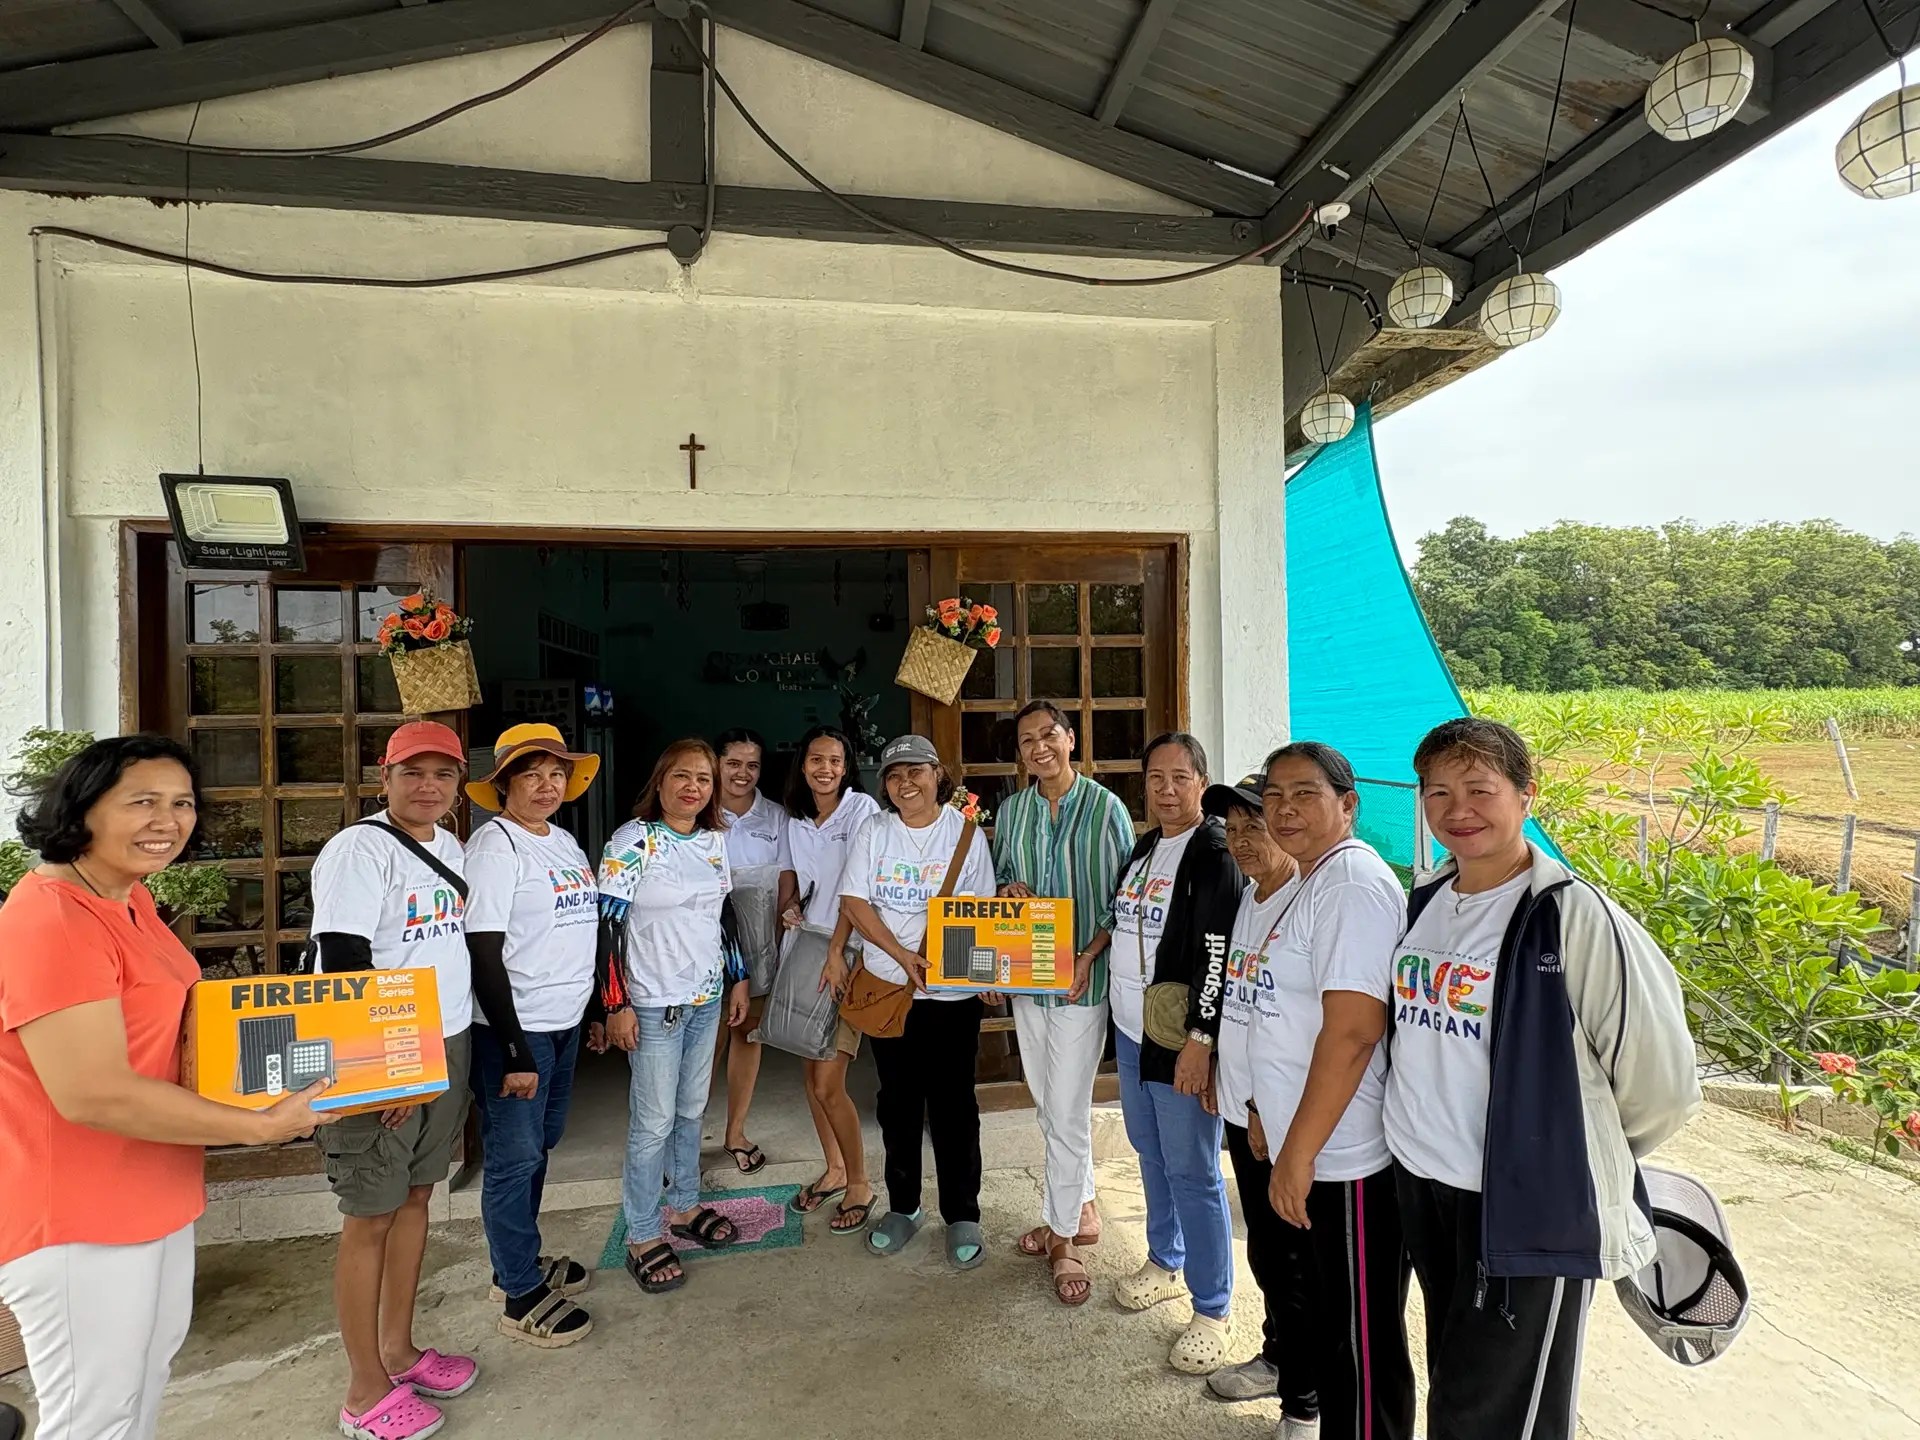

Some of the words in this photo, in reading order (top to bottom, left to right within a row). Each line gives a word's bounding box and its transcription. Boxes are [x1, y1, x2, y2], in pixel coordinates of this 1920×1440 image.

[200, 545, 230, 555] Solar
[235, 547, 264, 557] Light
[549, 867, 597, 893] LOV
[876, 859, 947, 886] LOVE
[876, 884, 904, 900] ANG
[554, 893, 581, 910] ANG
[943, 901, 1026, 919] FIREFLY
[1029, 901, 1056, 910] BASIC
[1030, 911, 1056, 921] Series
[402, 920, 465, 943] CAATA
[994, 923, 1027, 932] SOLAR
[231, 976, 371, 1010] FIREFLY
[376, 973, 415, 985] BASIC
[378, 987, 415, 998] Series
[369, 1003, 417, 1017] SOLAR
[1396, 1004, 1481, 1041] ATAGAN
